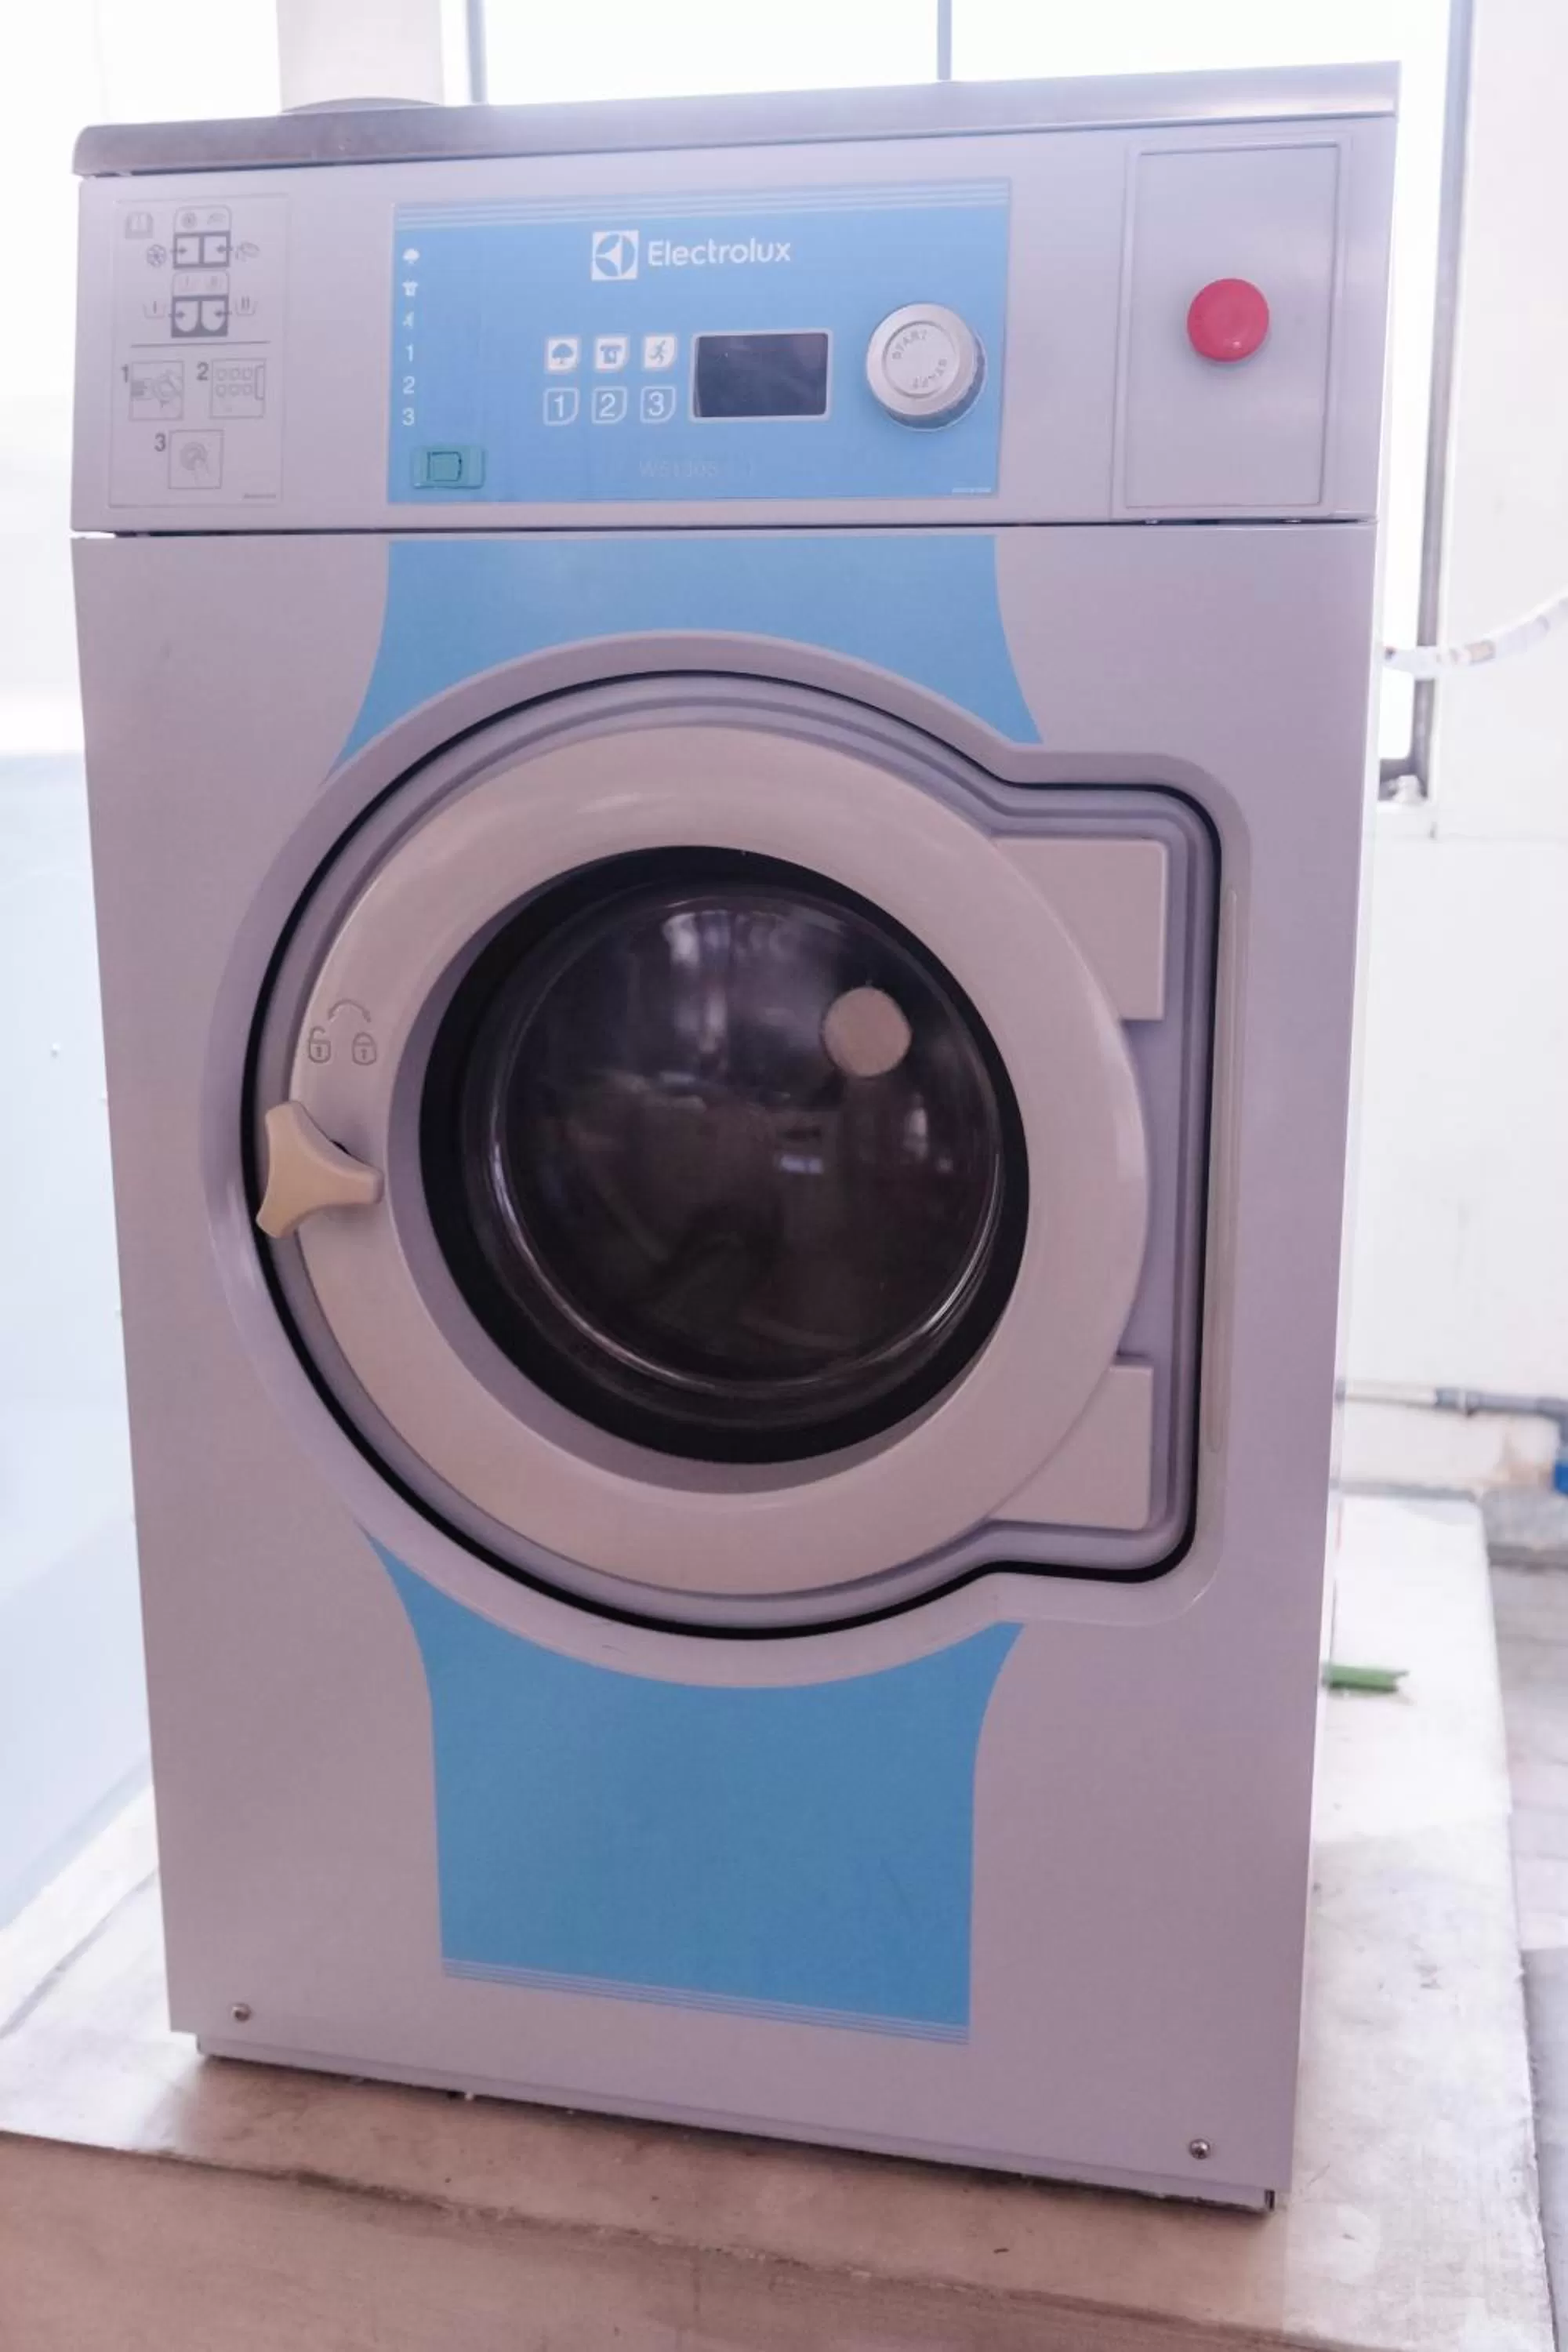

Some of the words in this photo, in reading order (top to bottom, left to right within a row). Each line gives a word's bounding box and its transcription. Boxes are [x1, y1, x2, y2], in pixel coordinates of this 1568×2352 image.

[647, 238, 791, 267] Electrolux
[405, 345, 414, 362] 1
[121, 363, 129, 383] 1
[196, 362, 209, 382] 2
[402, 376, 415, 394] 2
[554, 394, 565, 418] 1
[599, 393, 616, 418] 2
[648, 391, 665, 416] 3
[401, 408, 415, 426] 3
[154, 433, 166, 452] 3
